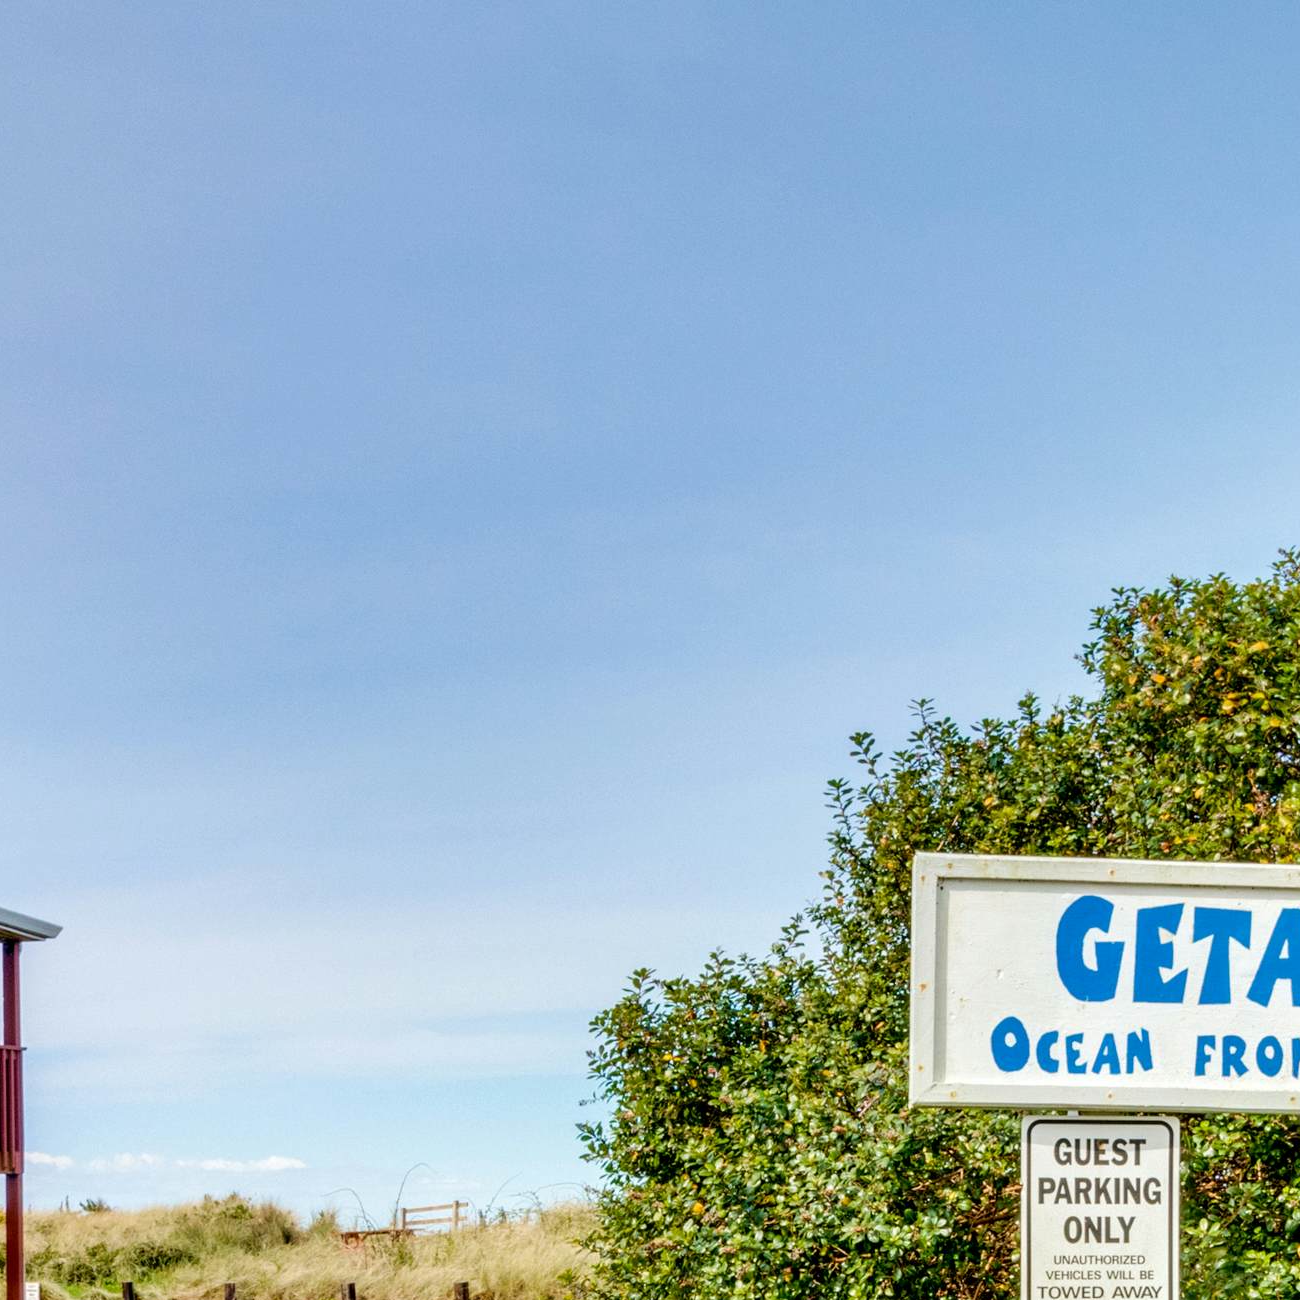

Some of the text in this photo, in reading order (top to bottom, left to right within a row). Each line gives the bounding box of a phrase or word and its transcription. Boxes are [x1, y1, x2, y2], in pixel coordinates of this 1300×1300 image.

[990, 1015, 1154, 1076] OCEAN
[1053, 1137, 1147, 1166] GUEST
[1037, 1177, 1162, 1205] PARKING
[1063, 1216, 1136, 1244] ONLY
[1053, 1254, 1146, 1265] UNAUTHORIZED
[1045, 1270, 1154, 1281] VEHICLES WILL BE
[1036, 1285, 1163, 1299] TOWED AWAY
